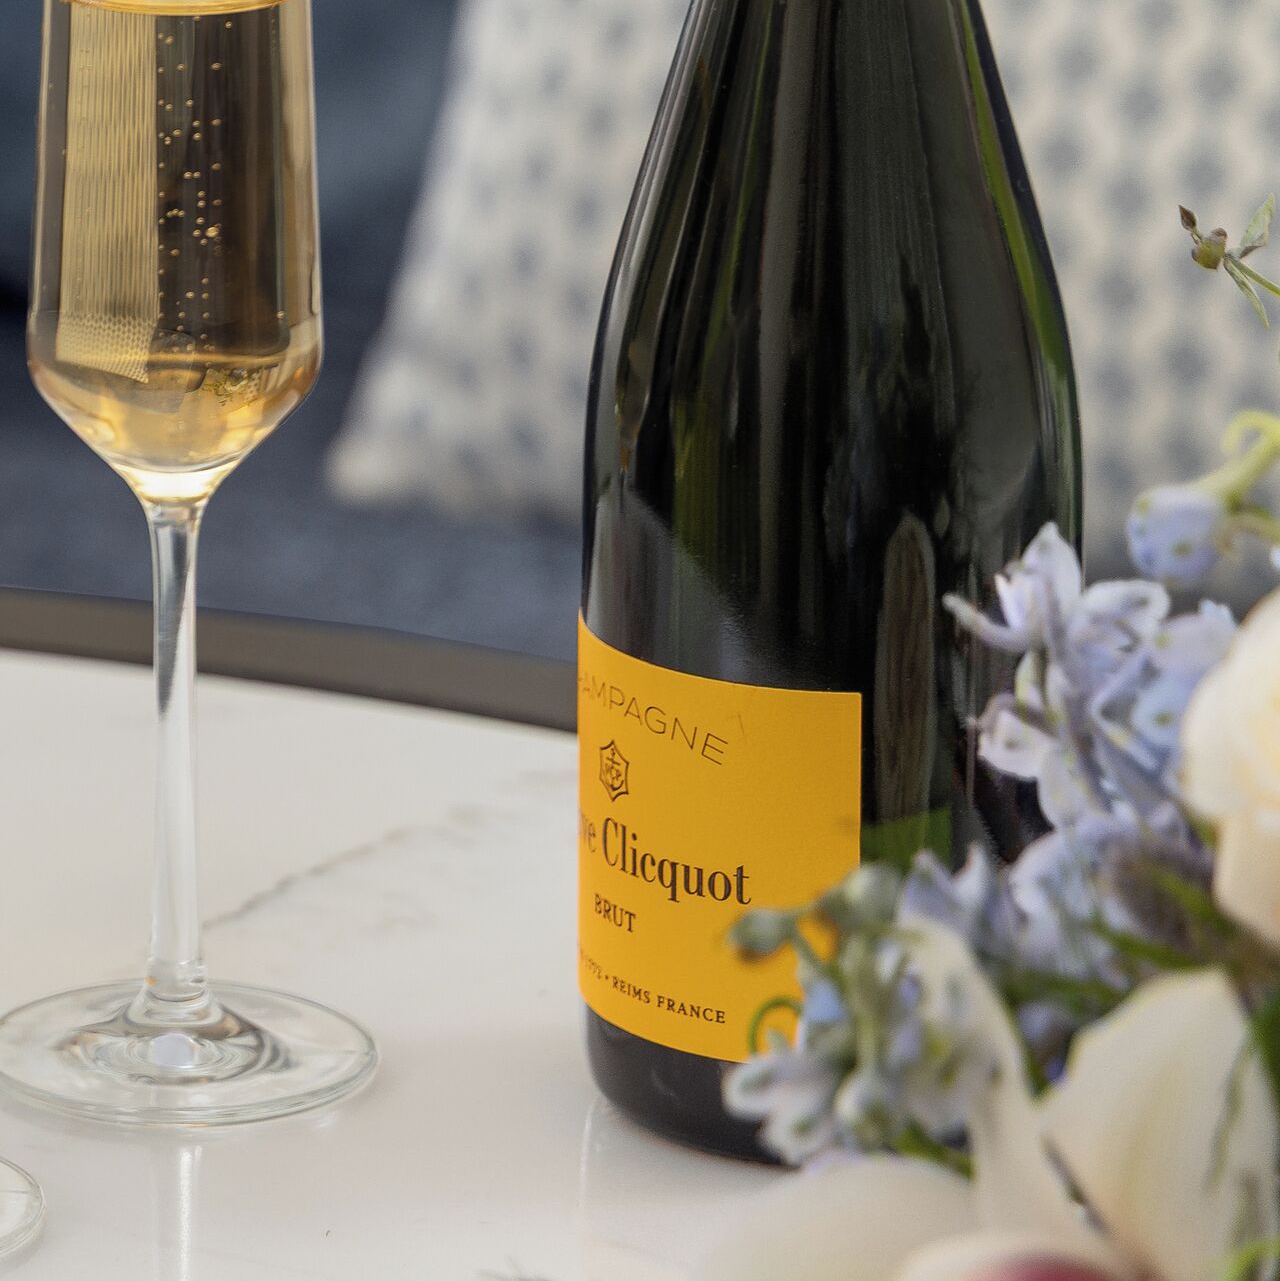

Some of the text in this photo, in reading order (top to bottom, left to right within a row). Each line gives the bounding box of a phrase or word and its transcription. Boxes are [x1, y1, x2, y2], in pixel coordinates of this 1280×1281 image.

[602, 817, 752, 906] Clicquot
[594, 892, 637, 933] BRUT
[611, 975, 727, 1025] REIMS FRANCE
